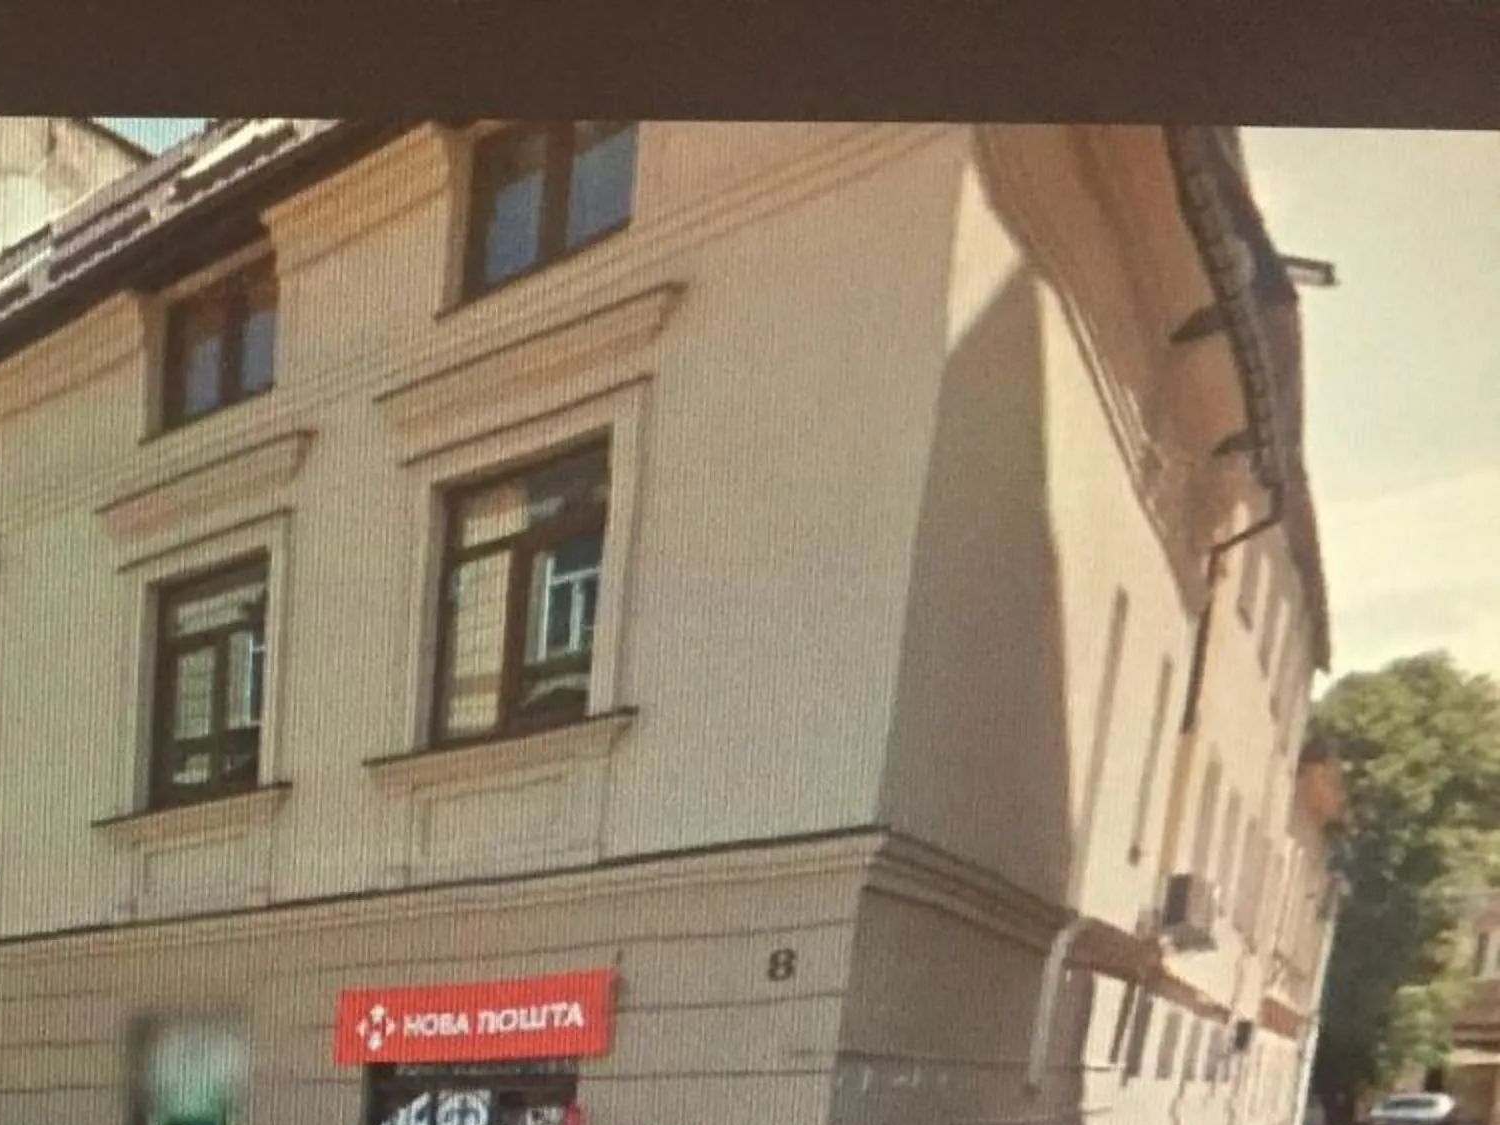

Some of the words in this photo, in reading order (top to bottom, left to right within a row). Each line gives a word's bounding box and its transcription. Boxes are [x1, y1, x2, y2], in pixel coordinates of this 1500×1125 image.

[768, 948, 797, 982] 8
[403, 1011, 471, 1038] НОВА
[477, 1001, 585, 1035] ПОШТА
